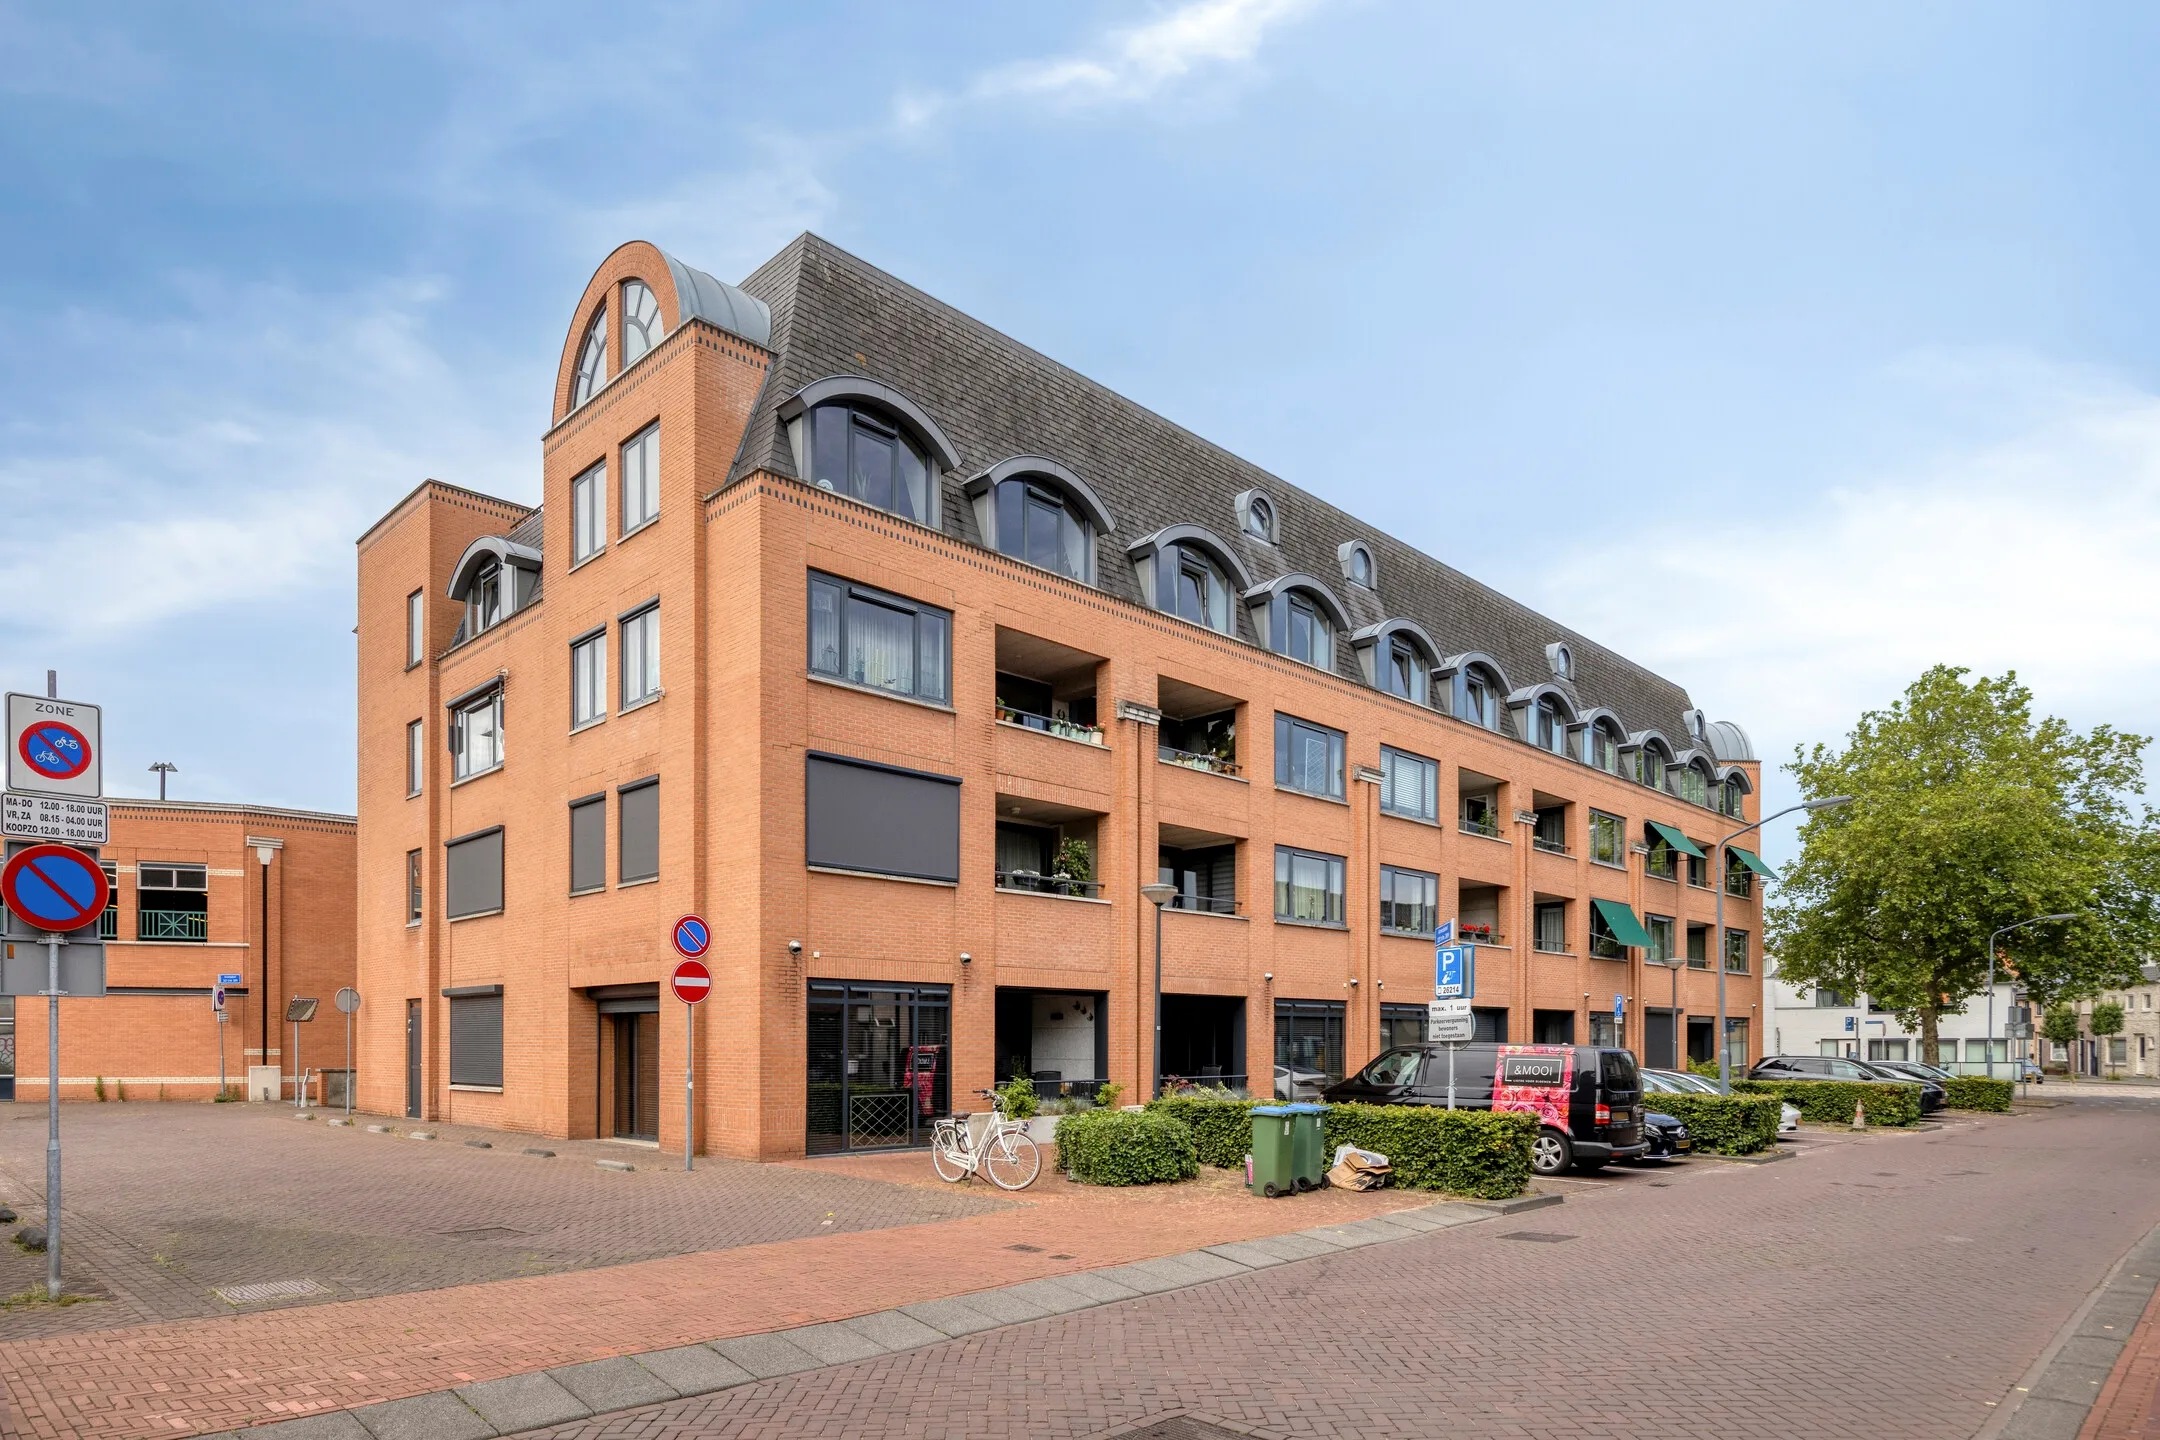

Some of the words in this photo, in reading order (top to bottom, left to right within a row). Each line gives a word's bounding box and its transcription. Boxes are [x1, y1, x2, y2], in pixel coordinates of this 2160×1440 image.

[35, 702, 75, 717] ZONE
[6, 797, 33, 808] MA-DO
[40, 801, 60, 811] 12.00
[66, 804, 86, 813] 18.00
[87, 806, 103, 815] UUR
[40, 813, 60, 823] 08.15
[66, 816, 86, 826] 04.00
[87, 819, 103, 827] UUR
[6, 822, 38, 834] KOOPZO
[40, 826, 60, 835] 12.00
[66, 828, 86, 838] 18.00
[87, 831, 103, 839] UUR
[1442, 951, 1455, 972] P
[1514, 1064, 1553, 1076] &MOOI
